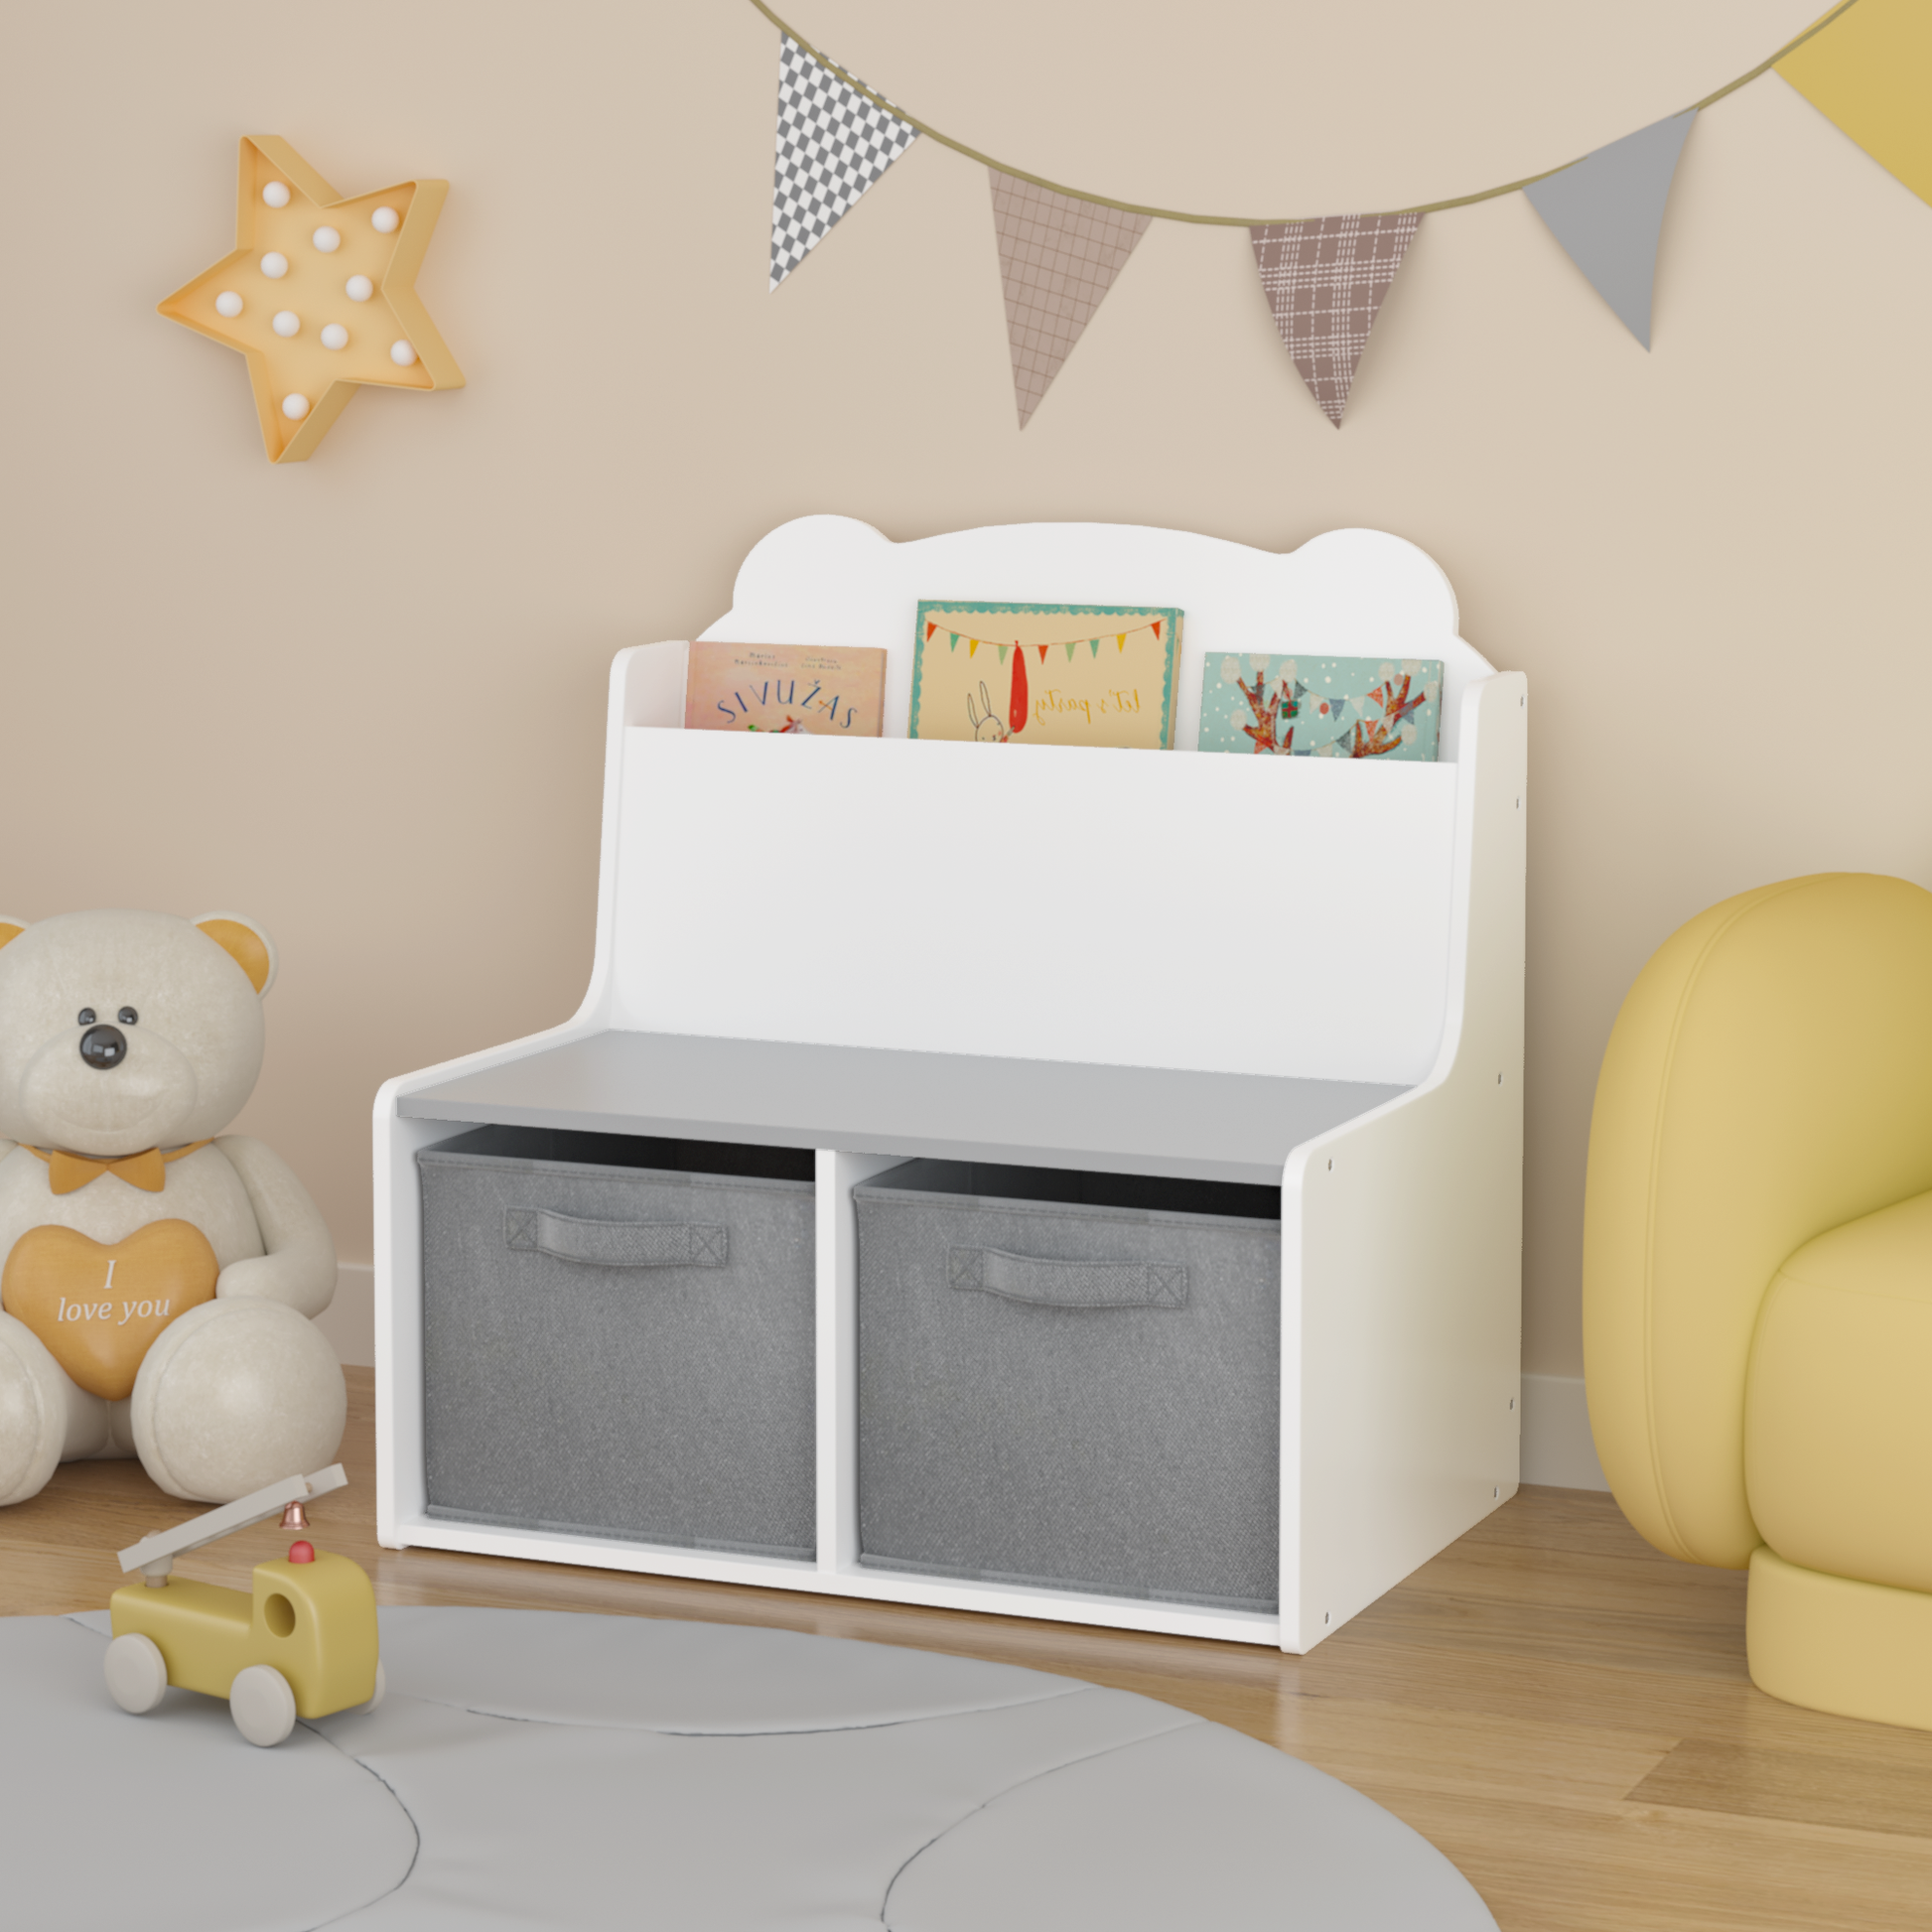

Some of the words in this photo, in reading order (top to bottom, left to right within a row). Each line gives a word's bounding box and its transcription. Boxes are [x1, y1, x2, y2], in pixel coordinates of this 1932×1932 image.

[717, 679, 858, 729] SIVUŽAS
[103, 1259, 117, 1290] I
[58, 1297, 113, 1321] love
[117, 1299, 170, 1325] you
